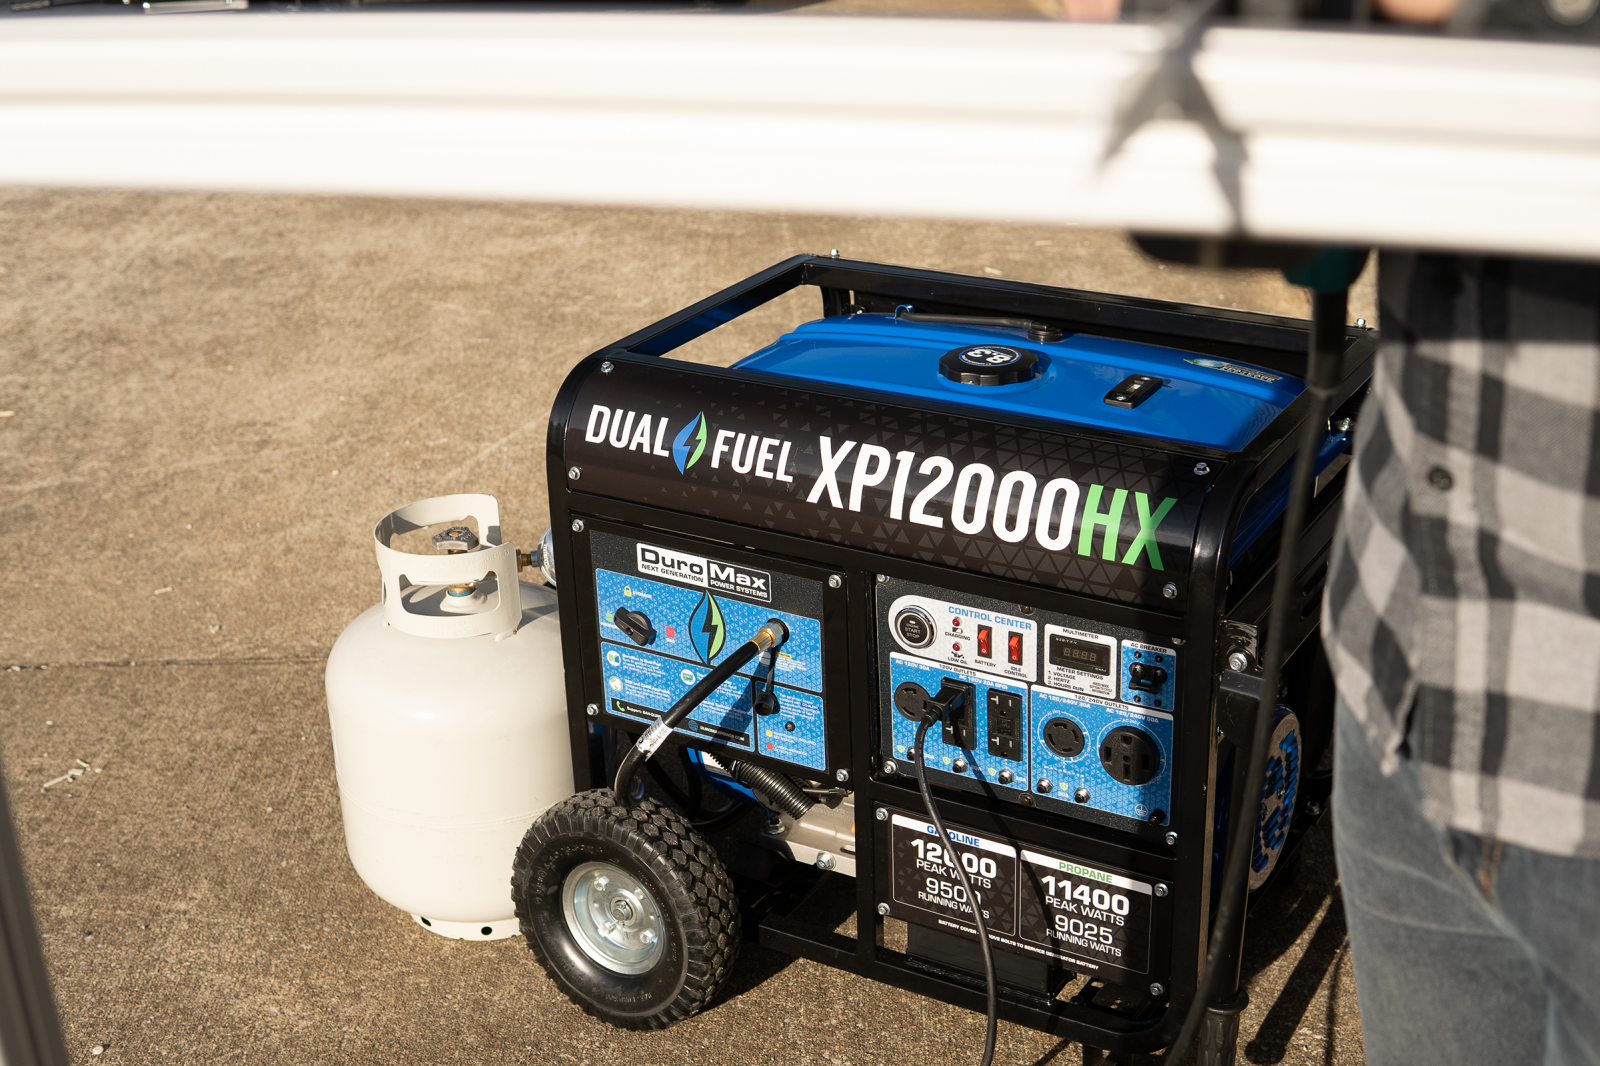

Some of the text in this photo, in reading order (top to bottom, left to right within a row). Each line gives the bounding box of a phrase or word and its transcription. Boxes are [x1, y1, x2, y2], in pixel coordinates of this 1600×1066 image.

[585, 404, 793, 482] DUAL FUEL
[805, 435, 1178, 571] XP12000HX
[641, 563, 704, 583] NEXT GENERATION
[710, 579, 768, 599] POWER SYSTEMS
[948, 606, 1032, 631] CONTROL CENTER
[905, 626, 921, 634] START
[944, 631, 971, 641] CHARGING
[1062, 628, 1099, 640] MULTIMETER
[1140, 643, 1168, 655] BREAKER
[904, 661, 919, 669] 120V
[918, 664, 930, 672] 30A
[974, 659, 997, 668] BATTERY
[1010, 665, 1022, 673] IDLE
[953, 666, 977, 677] OUTLETS
[1004, 669, 1028, 679] CONTROL
[1053, 671, 1076, 681] VOLTAGE
[1056, 666, 1076, 675] METER
[1076, 669, 1104, 681] SETTINGS
[967, 675, 982, 685] 120V
[982, 679, 994, 687] 20A
[994, 682, 1008, 690] GFCI
[1053, 676, 1071, 684] HERTZ
[1053, 681, 1072, 690] HOURS
[1048, 694, 1078, 706] 120/240V
[1078, 701, 1091, 709] 30A
[1074, 694, 1129, 711] 120/240V OUTLETS
[1116, 709, 1146, 721] 120/240V
[1146, 716, 1159, 724] 50A
[926, 825, 980, 847] GOLINE
[916, 859, 992, 889] PEAK WTTS
[1059, 861, 1113, 884] PROPANE
[1041, 875, 1130, 916] 11400
[918, 891, 990, 919] RUNNING WAS
[1045, 895, 1125, 927] PEAK WATTS
[1054, 914, 1113, 945] 9025
[938, 919, 960, 929] BATTERY
[960, 925, 977, 935] COVER
[1000, 938, 1017, 947] BOLTS
[1024, 944, 1046, 956] SERVICE
[1045, 950, 1076, 964] GENERATOR
[1076, 959, 1100, 971] BATTERY
[1046, 928, 1122, 957] RUNNING WATTS
